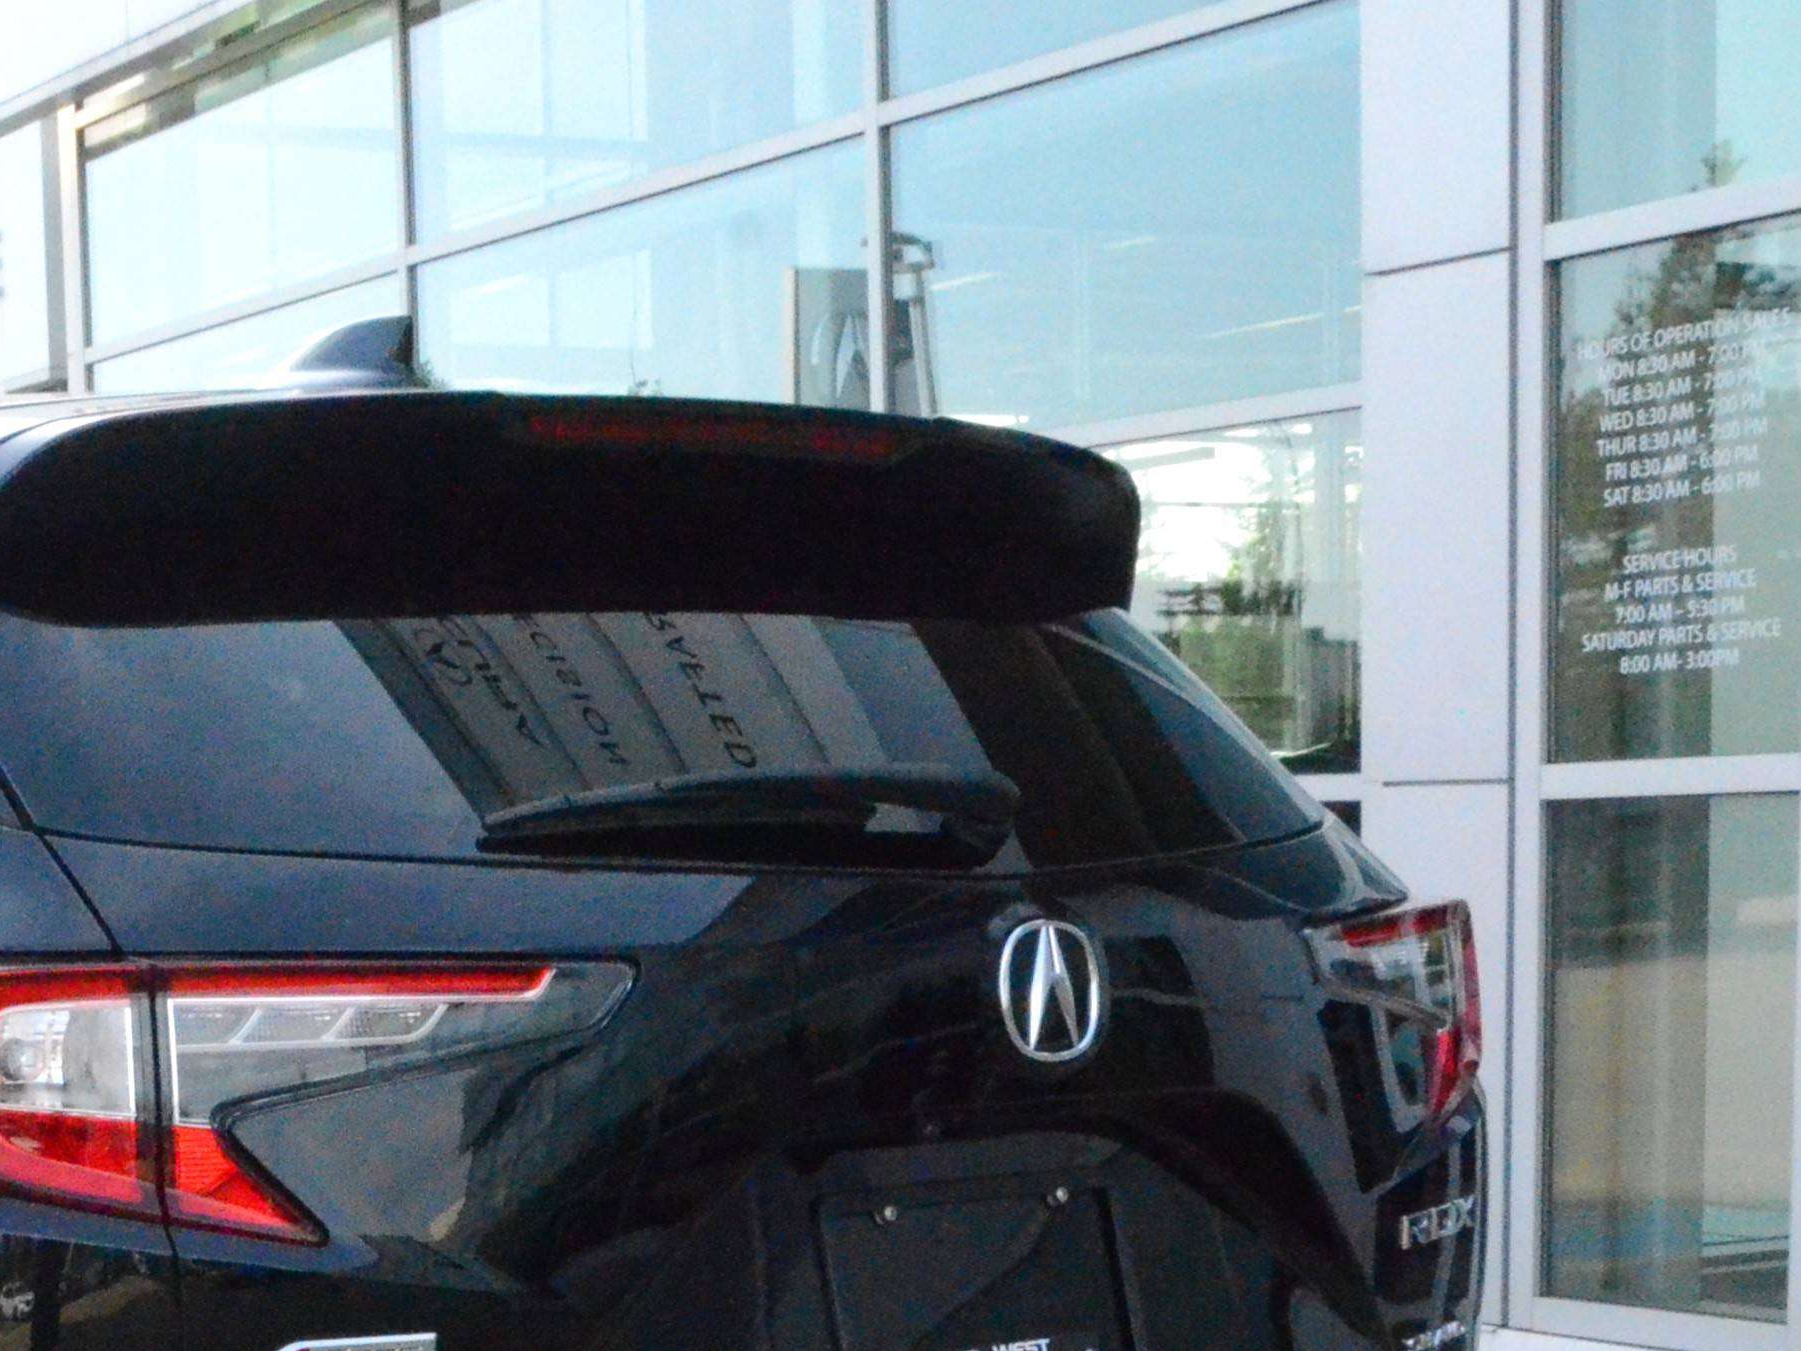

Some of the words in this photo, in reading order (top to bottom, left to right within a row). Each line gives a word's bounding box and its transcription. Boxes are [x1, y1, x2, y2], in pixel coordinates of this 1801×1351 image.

[1630, 332, 1651, 351] OF
[1654, 315, 1738, 348] OPERATION
[1600, 359, 1635, 383] MON
[1670, 348, 1695, 370] AM
[1601, 386, 1631, 407] TUE
[1633, 382, 1664, 402] 8:30
[1666, 376, 1691, 397] AM
[1600, 412, 1634, 432] WED
[1636, 407, 1667, 427] 8:30
[1669, 402, 1694, 422] AM
[1596, 436, 1636, 457] THUR
[1639, 431, 1669, 451] 8:30
[1672, 427, 1696, 447] AM
[1605, 462, 1627, 482] FRI
[1630, 458, 1660, 478] 8:30
[1662, 454, 1688, 474] AM
[1734, 444, 1759, 463] PM
[1603, 486, 1630, 508] SAT
[1632, 483, 1663, 503] 8:30
[1665, 479, 1690, 500] AM
[1736, 470, 1760, 490] PM
[1622, 551, 1680, 575] SERVICE
[1683, 545, 1736, 567] HOURS
[1604, 581, 1632, 602] M-F
[1635, 575, 1679, 599] PARTS
[1681, 576, 1694, 594] &
[1696, 567, 1757, 592] SERVICE
[1615, 605, 1645, 625] 7:00
[1648, 602, 1673, 622] AM
[1721, 595, 1745, 615] PM
[1581, 629, 1656, 653] SATURDAY
[1659, 624, 1704, 646] PARTS
[1721, 615, 1781, 641] SERVICE
[1399, 1194, 1477, 1250] RDX
